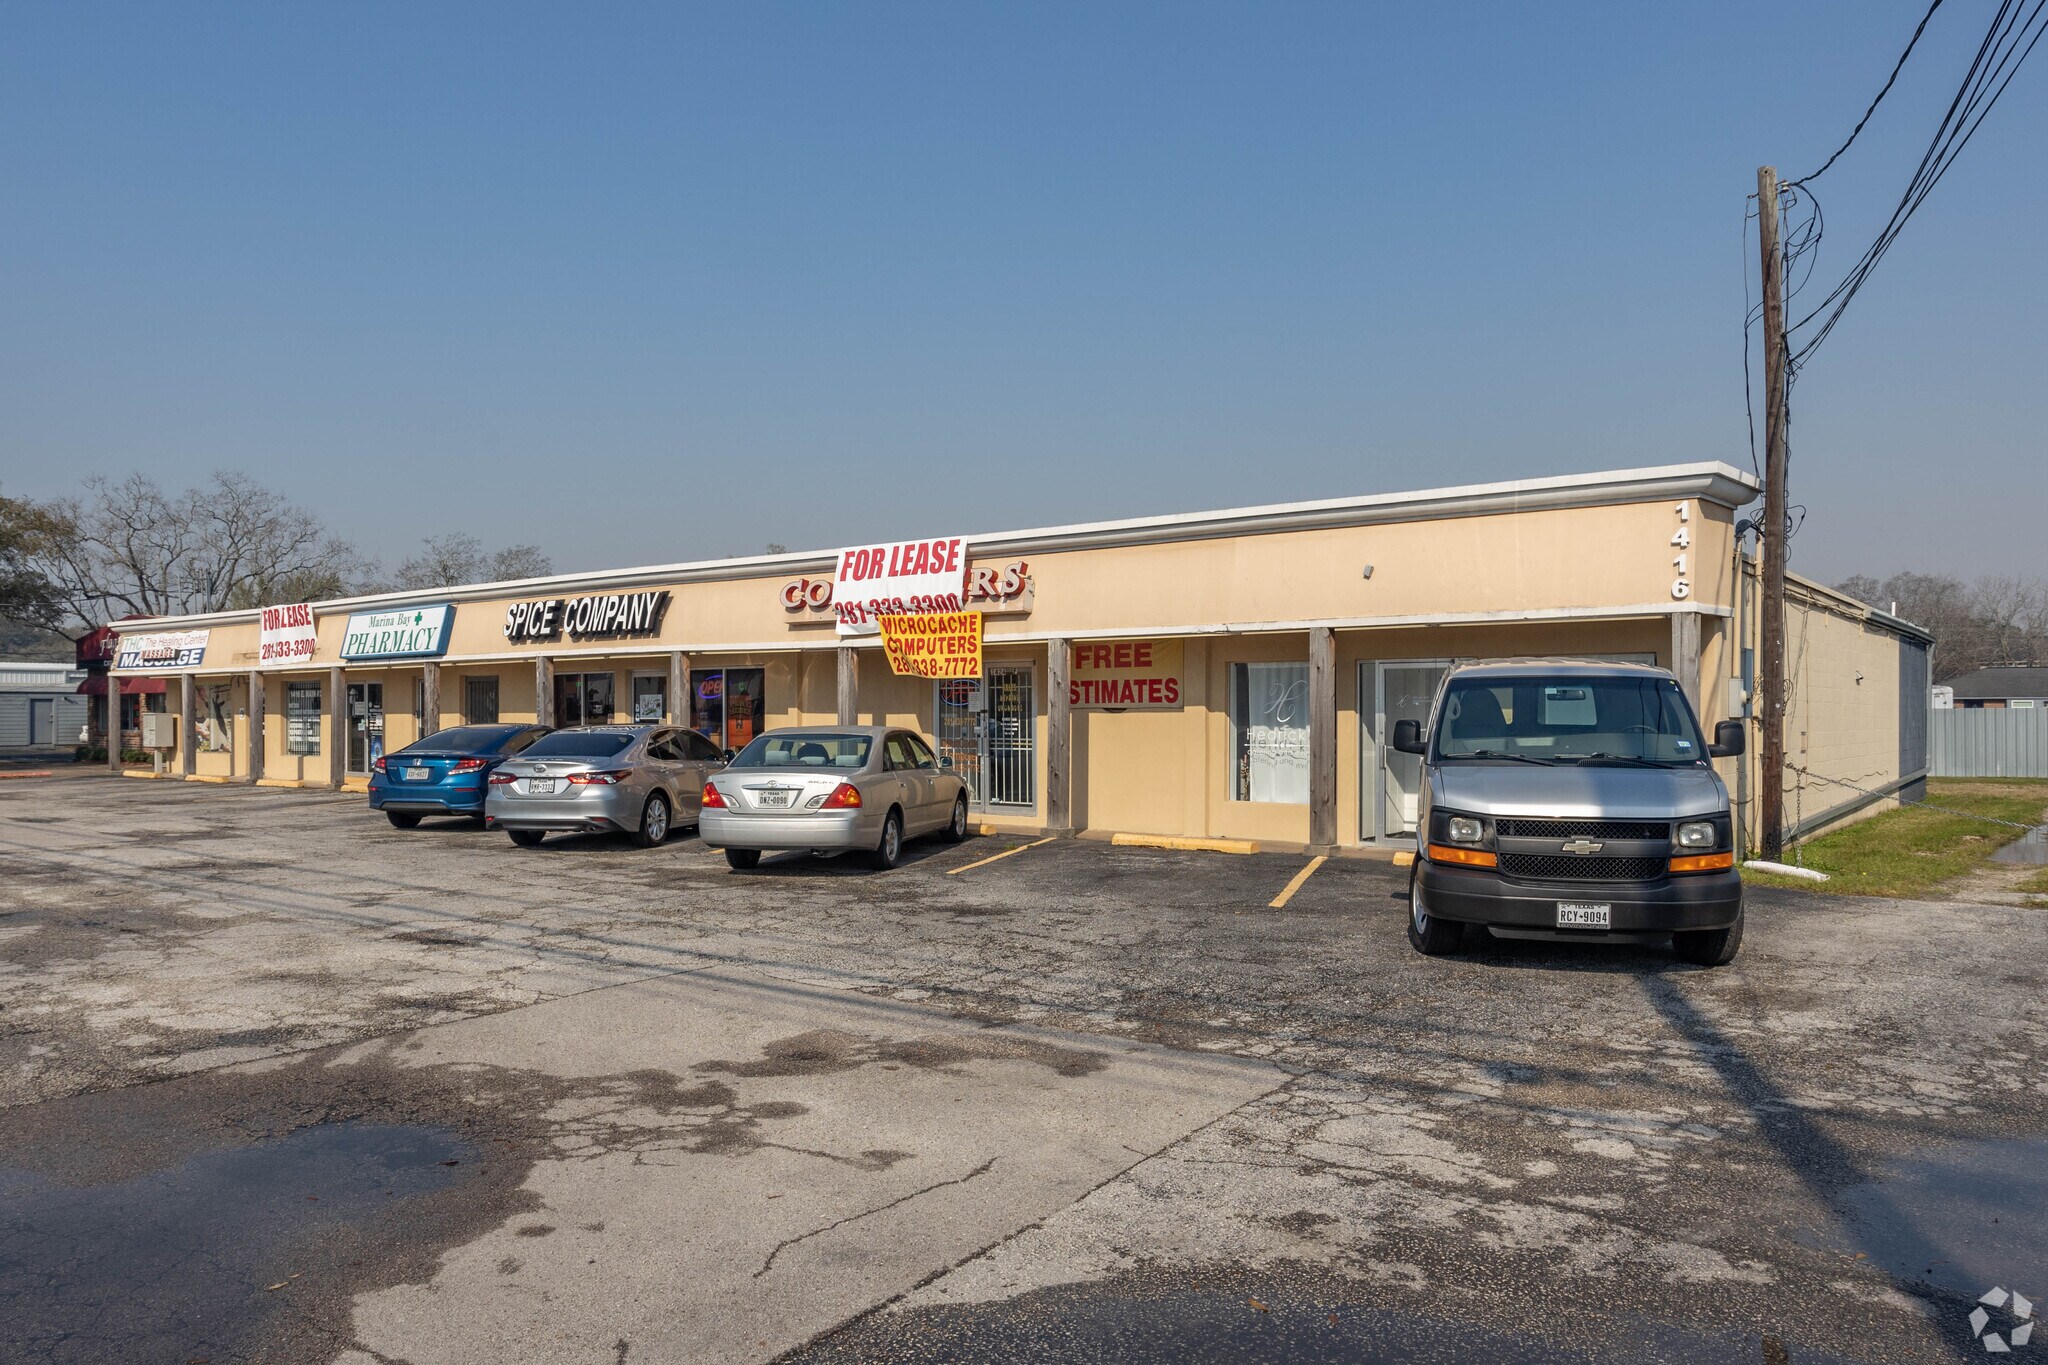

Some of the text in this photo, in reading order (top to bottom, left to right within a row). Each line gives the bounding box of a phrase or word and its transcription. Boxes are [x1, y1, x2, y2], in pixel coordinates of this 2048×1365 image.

[840, 539, 961, 582] FOR LEASE
[1671, 500, 1690, 598] 1416
[262, 604, 312, 631] FOR LEASE
[368, 613, 412, 628] Marina Bay
[503, 592, 660, 637] SPICE COMPANY
[881, 614, 978, 635] MICROCACHE
[124, 634, 208, 651] THC The Healing Center
[141, 648, 174, 658] MASSAGE
[261, 638, 316, 660] 281-33-3300
[345, 627, 438, 655] PHARMACY
[887, 635, 978, 656] COMPUTERS
[893, 657, 979, 677] 28338-7772
[1075, 643, 1153, 669] FREE
[1070, 677, 1179, 705] STIMATES
